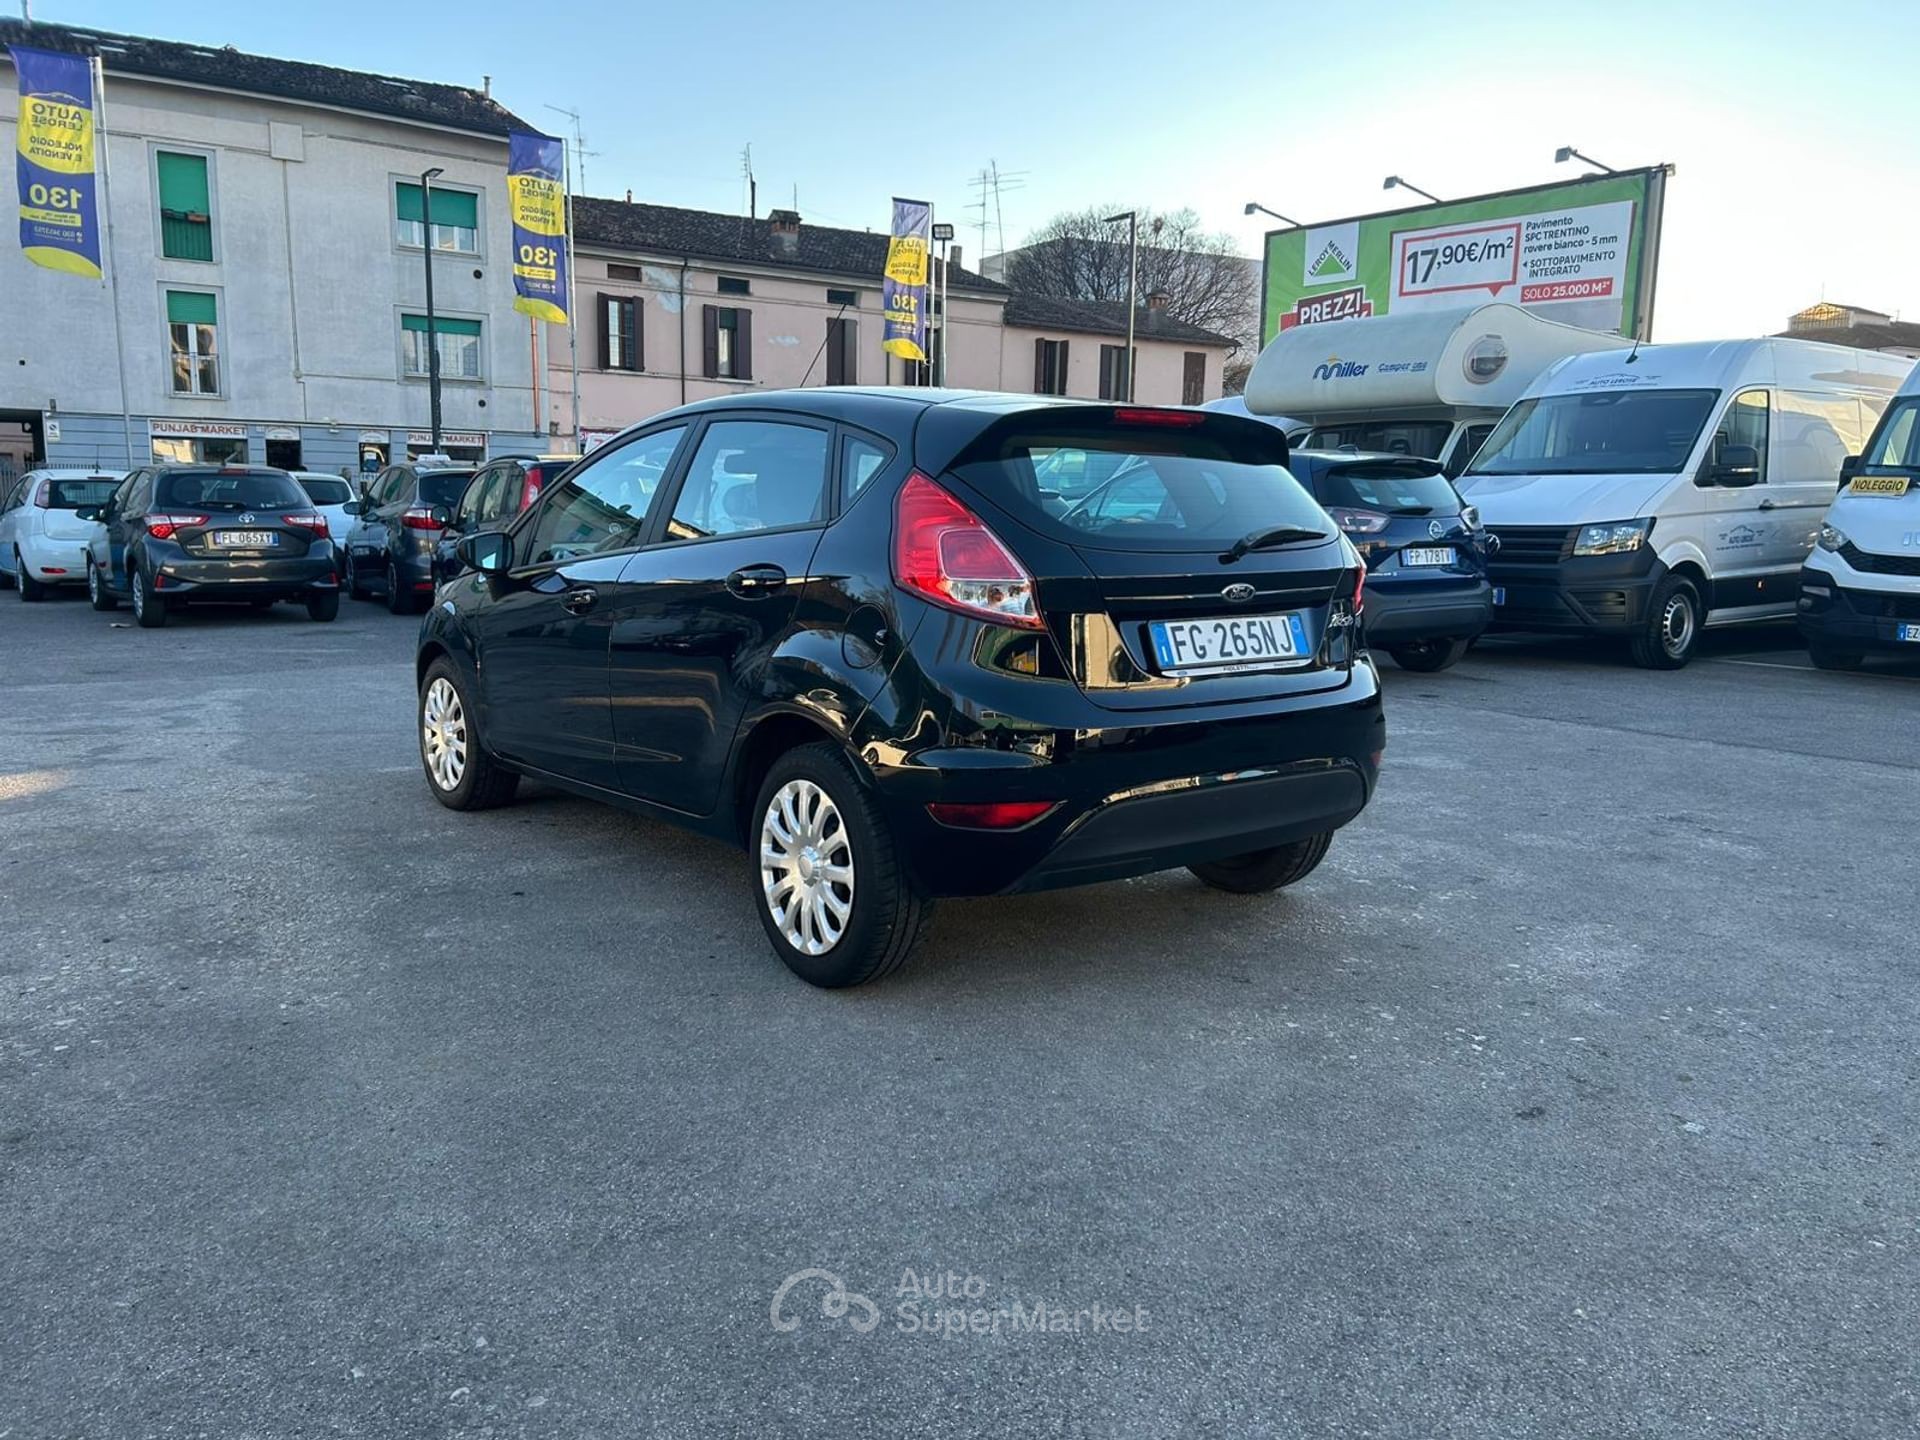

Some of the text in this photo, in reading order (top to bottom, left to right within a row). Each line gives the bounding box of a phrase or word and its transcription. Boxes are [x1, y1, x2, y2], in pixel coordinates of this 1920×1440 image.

[1526, 217, 1573, 231] Pavimento
[1525, 225, 1590, 242] SPC TRENTINO
[1524, 243, 1552, 253] rovere
[1553, 239, 1584, 250] bianco
[1591, 236, 1598, 245] 5
[1599, 235, 1618, 244] mm
[1308, 240, 1353, 276] LEROY MERLIN
[1529, 250, 1616, 268] SOTTOPAVIMENTO
[1528, 264, 1581, 278] INTEGRATO
[1523, 287, 1551, 299] SOLO
[1551, 284, 1590, 297] 25.000
[1300, 292, 1361, 324] PREZZI
[1312, 361, 1370, 380] Miller
[152, 422, 246, 436] PUNJAB MARKET
[447, 434, 483, 443] MARKET
[1852, 480, 1904, 491] NOLEGGIO
[222, 533, 234, 544] FL
[1410, 551, 1421, 563] FP
[1170, 624, 1208, 662] FG
[1213, 617, 1293, 658] 265NJ
[1906, 627, 1919, 639] EZ
